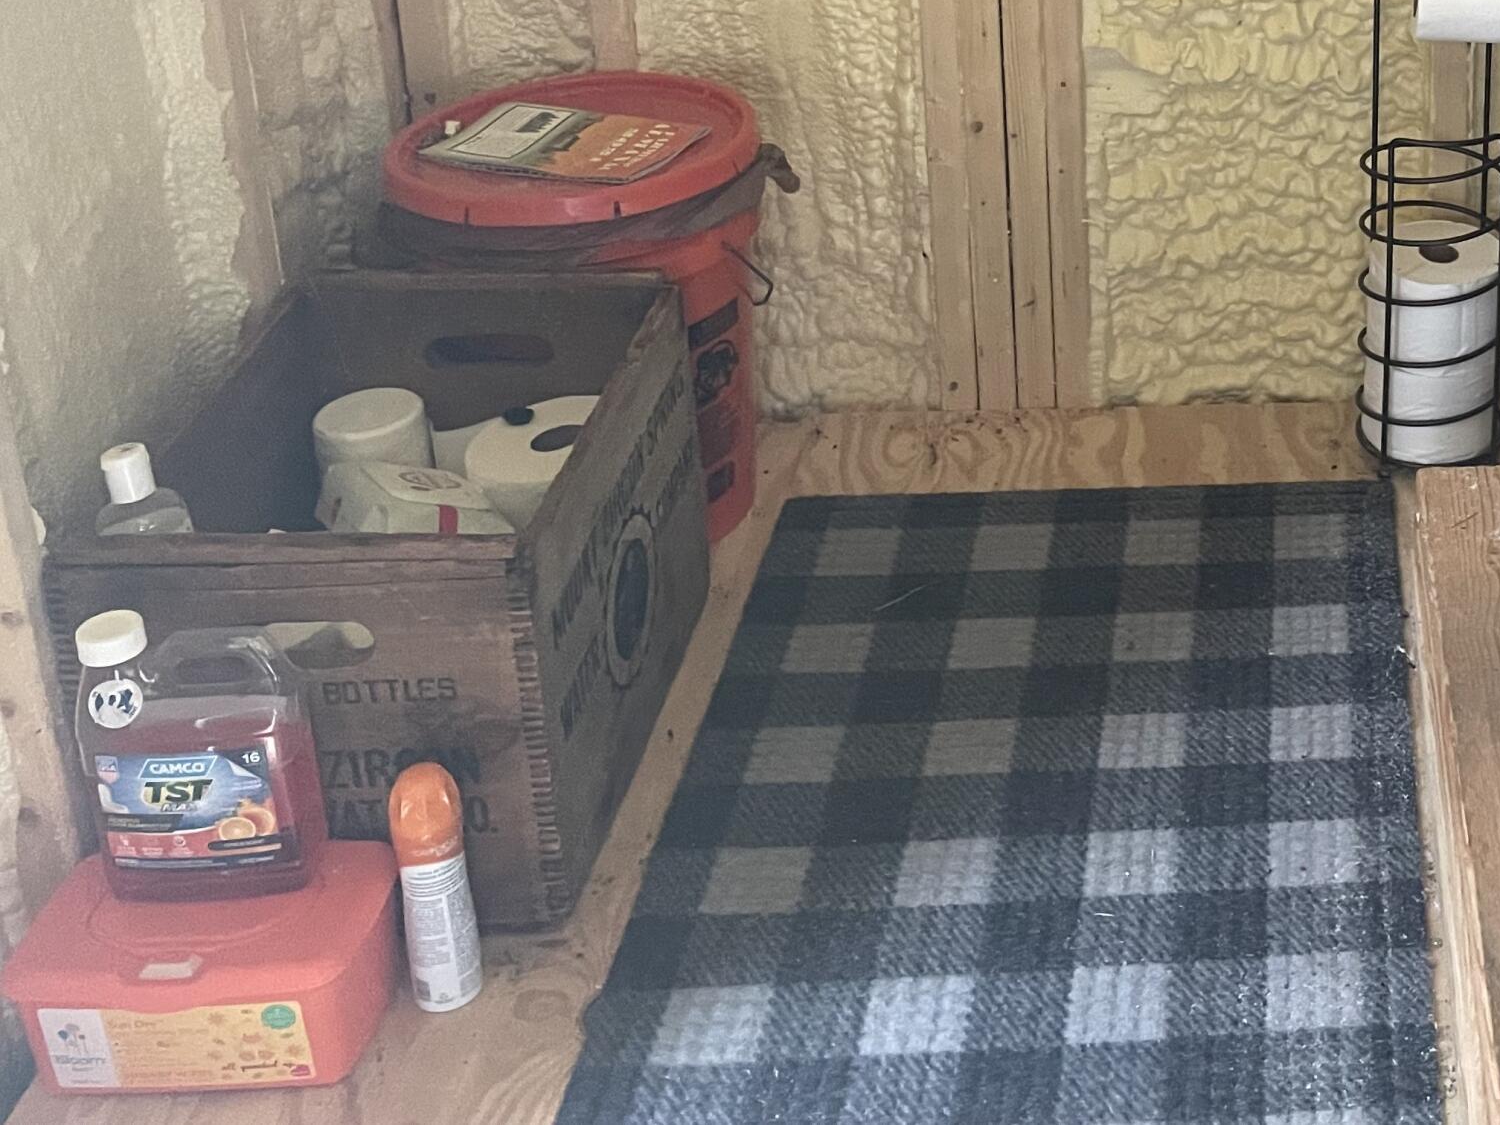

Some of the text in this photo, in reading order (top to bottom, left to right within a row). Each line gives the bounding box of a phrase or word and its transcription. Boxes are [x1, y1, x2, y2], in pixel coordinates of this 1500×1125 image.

[321, 676, 458, 705] BOTTLES
[148, 760, 206, 775] CAMCO
[241, 751, 261, 764] 16
[144, 778, 213, 804] TST
